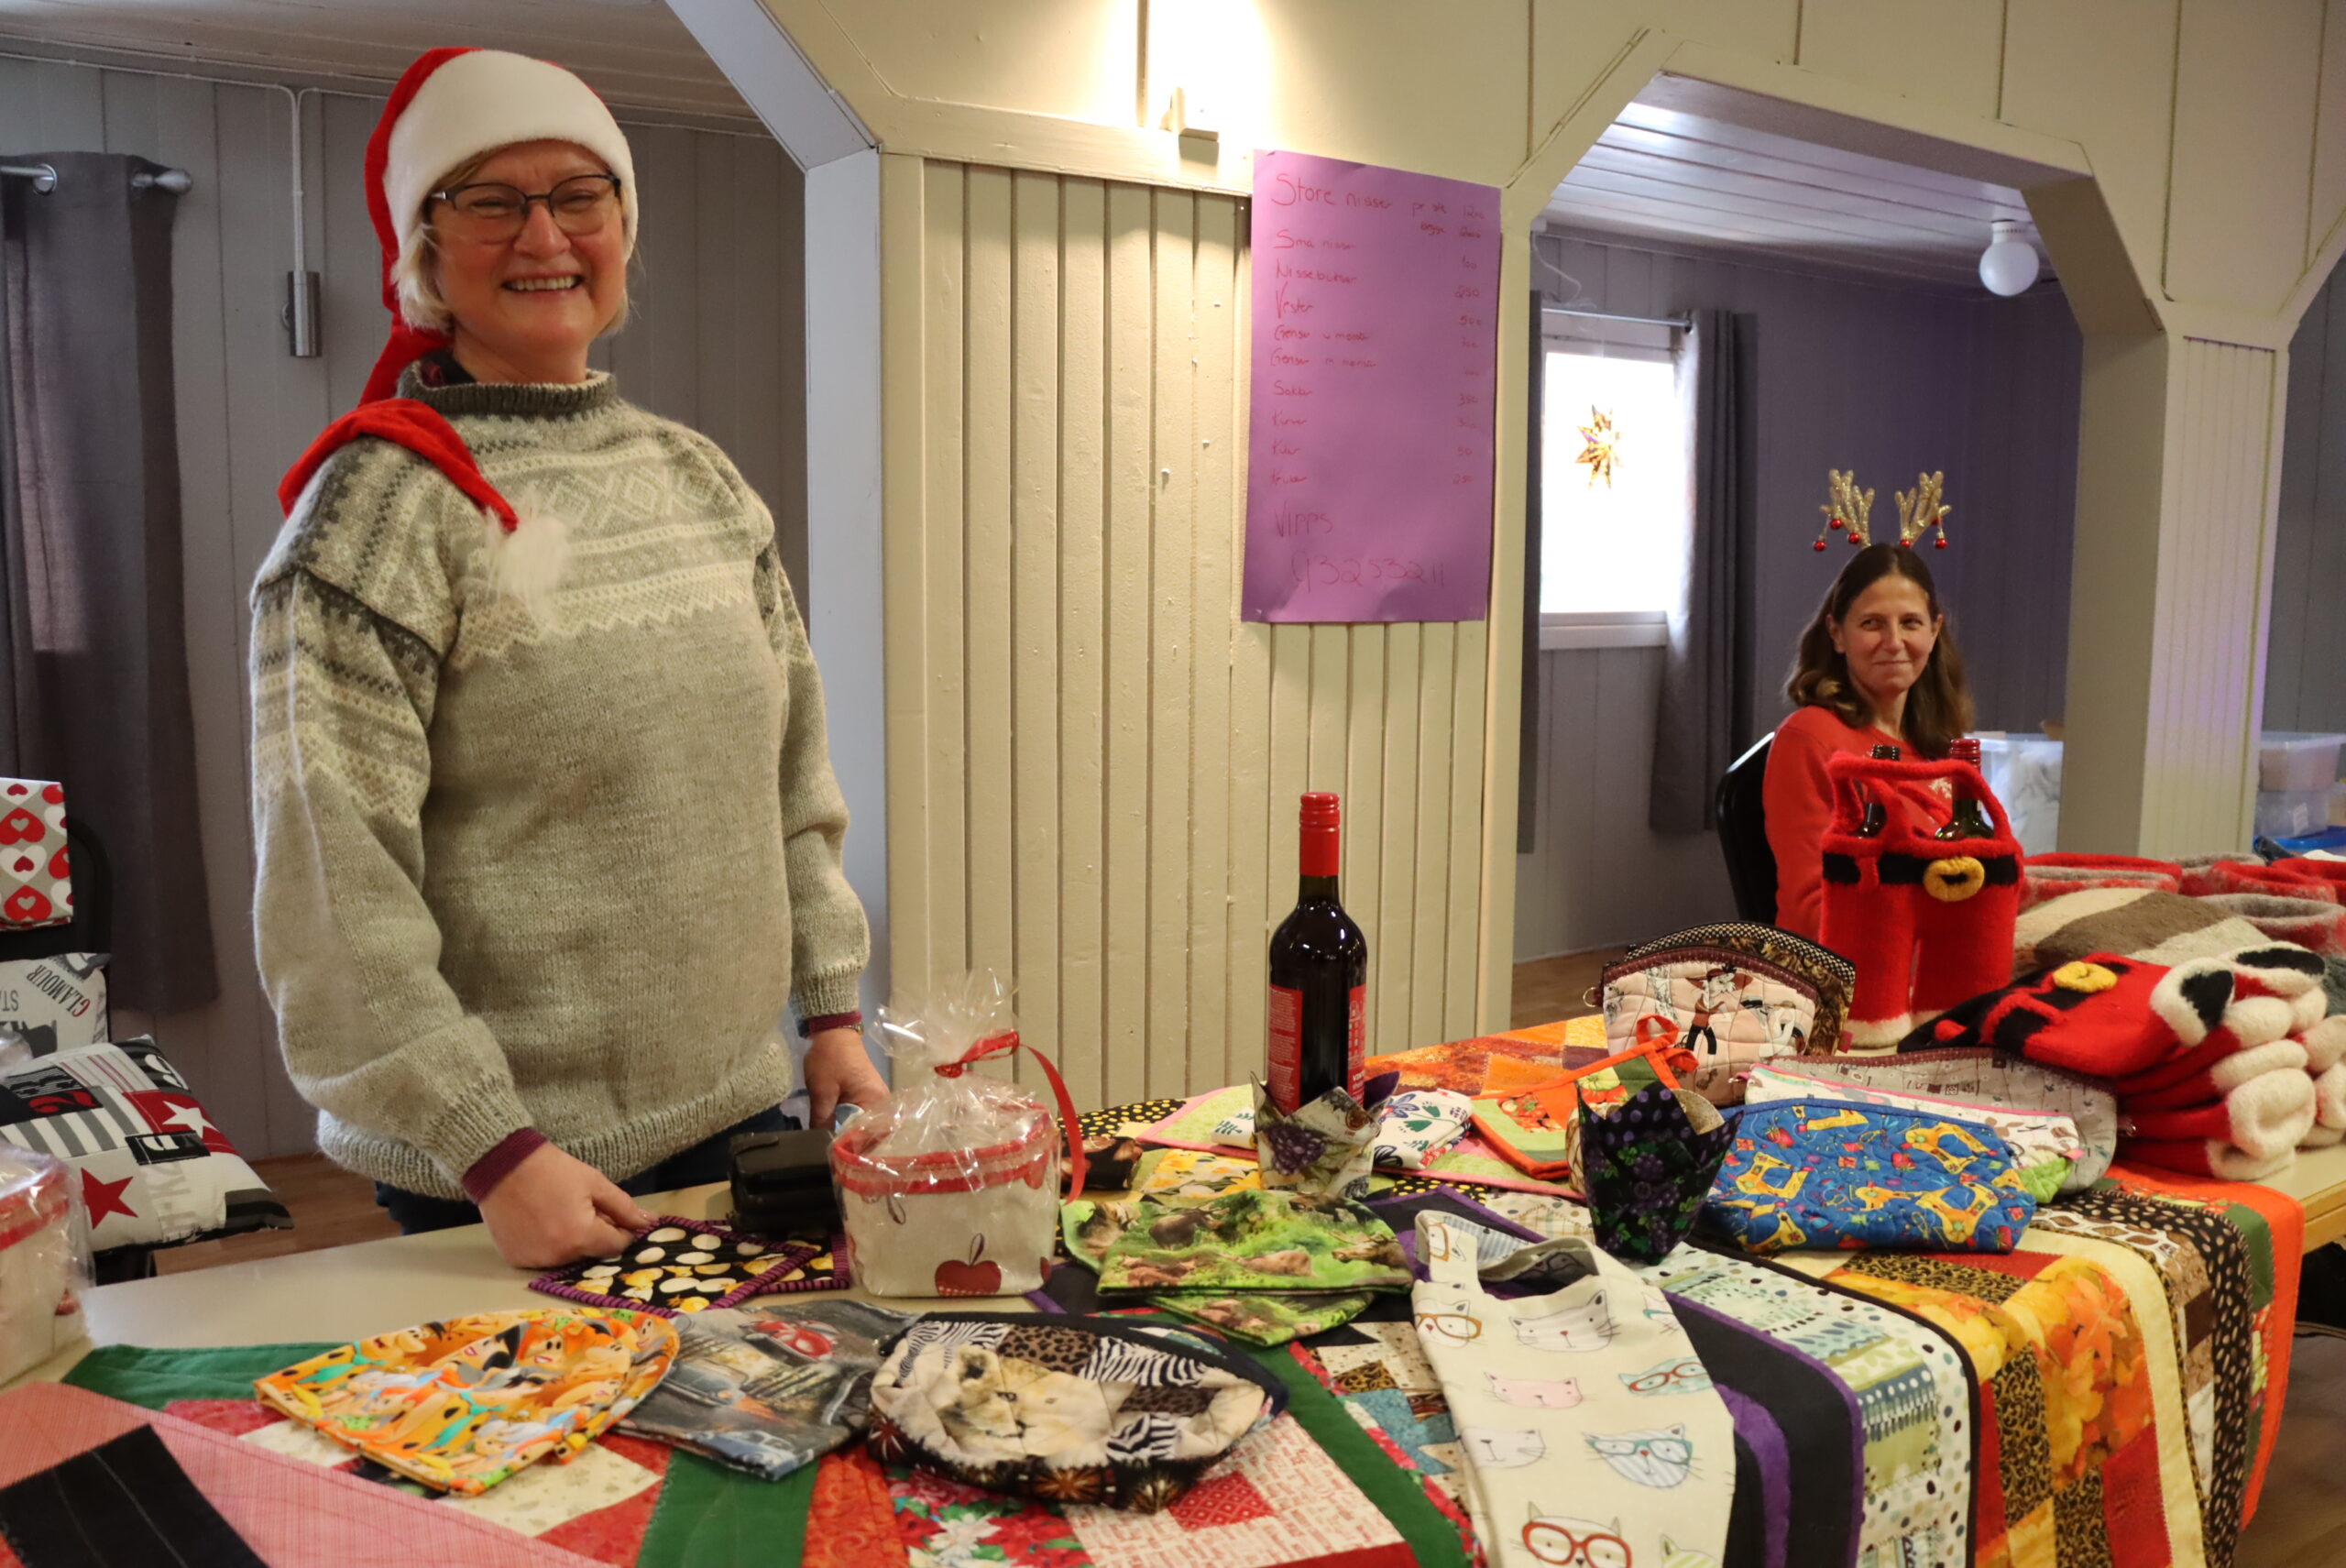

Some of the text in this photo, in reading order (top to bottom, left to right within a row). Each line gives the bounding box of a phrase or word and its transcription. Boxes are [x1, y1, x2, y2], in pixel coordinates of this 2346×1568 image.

[1271, 172, 1336, 205] Store
[1346, 192, 1393, 210] nisser
[1276, 281, 1314, 319] Vester
[0, 990, 18, 1012] ST
[26, 964, 91, 1017] GLAMOUR
